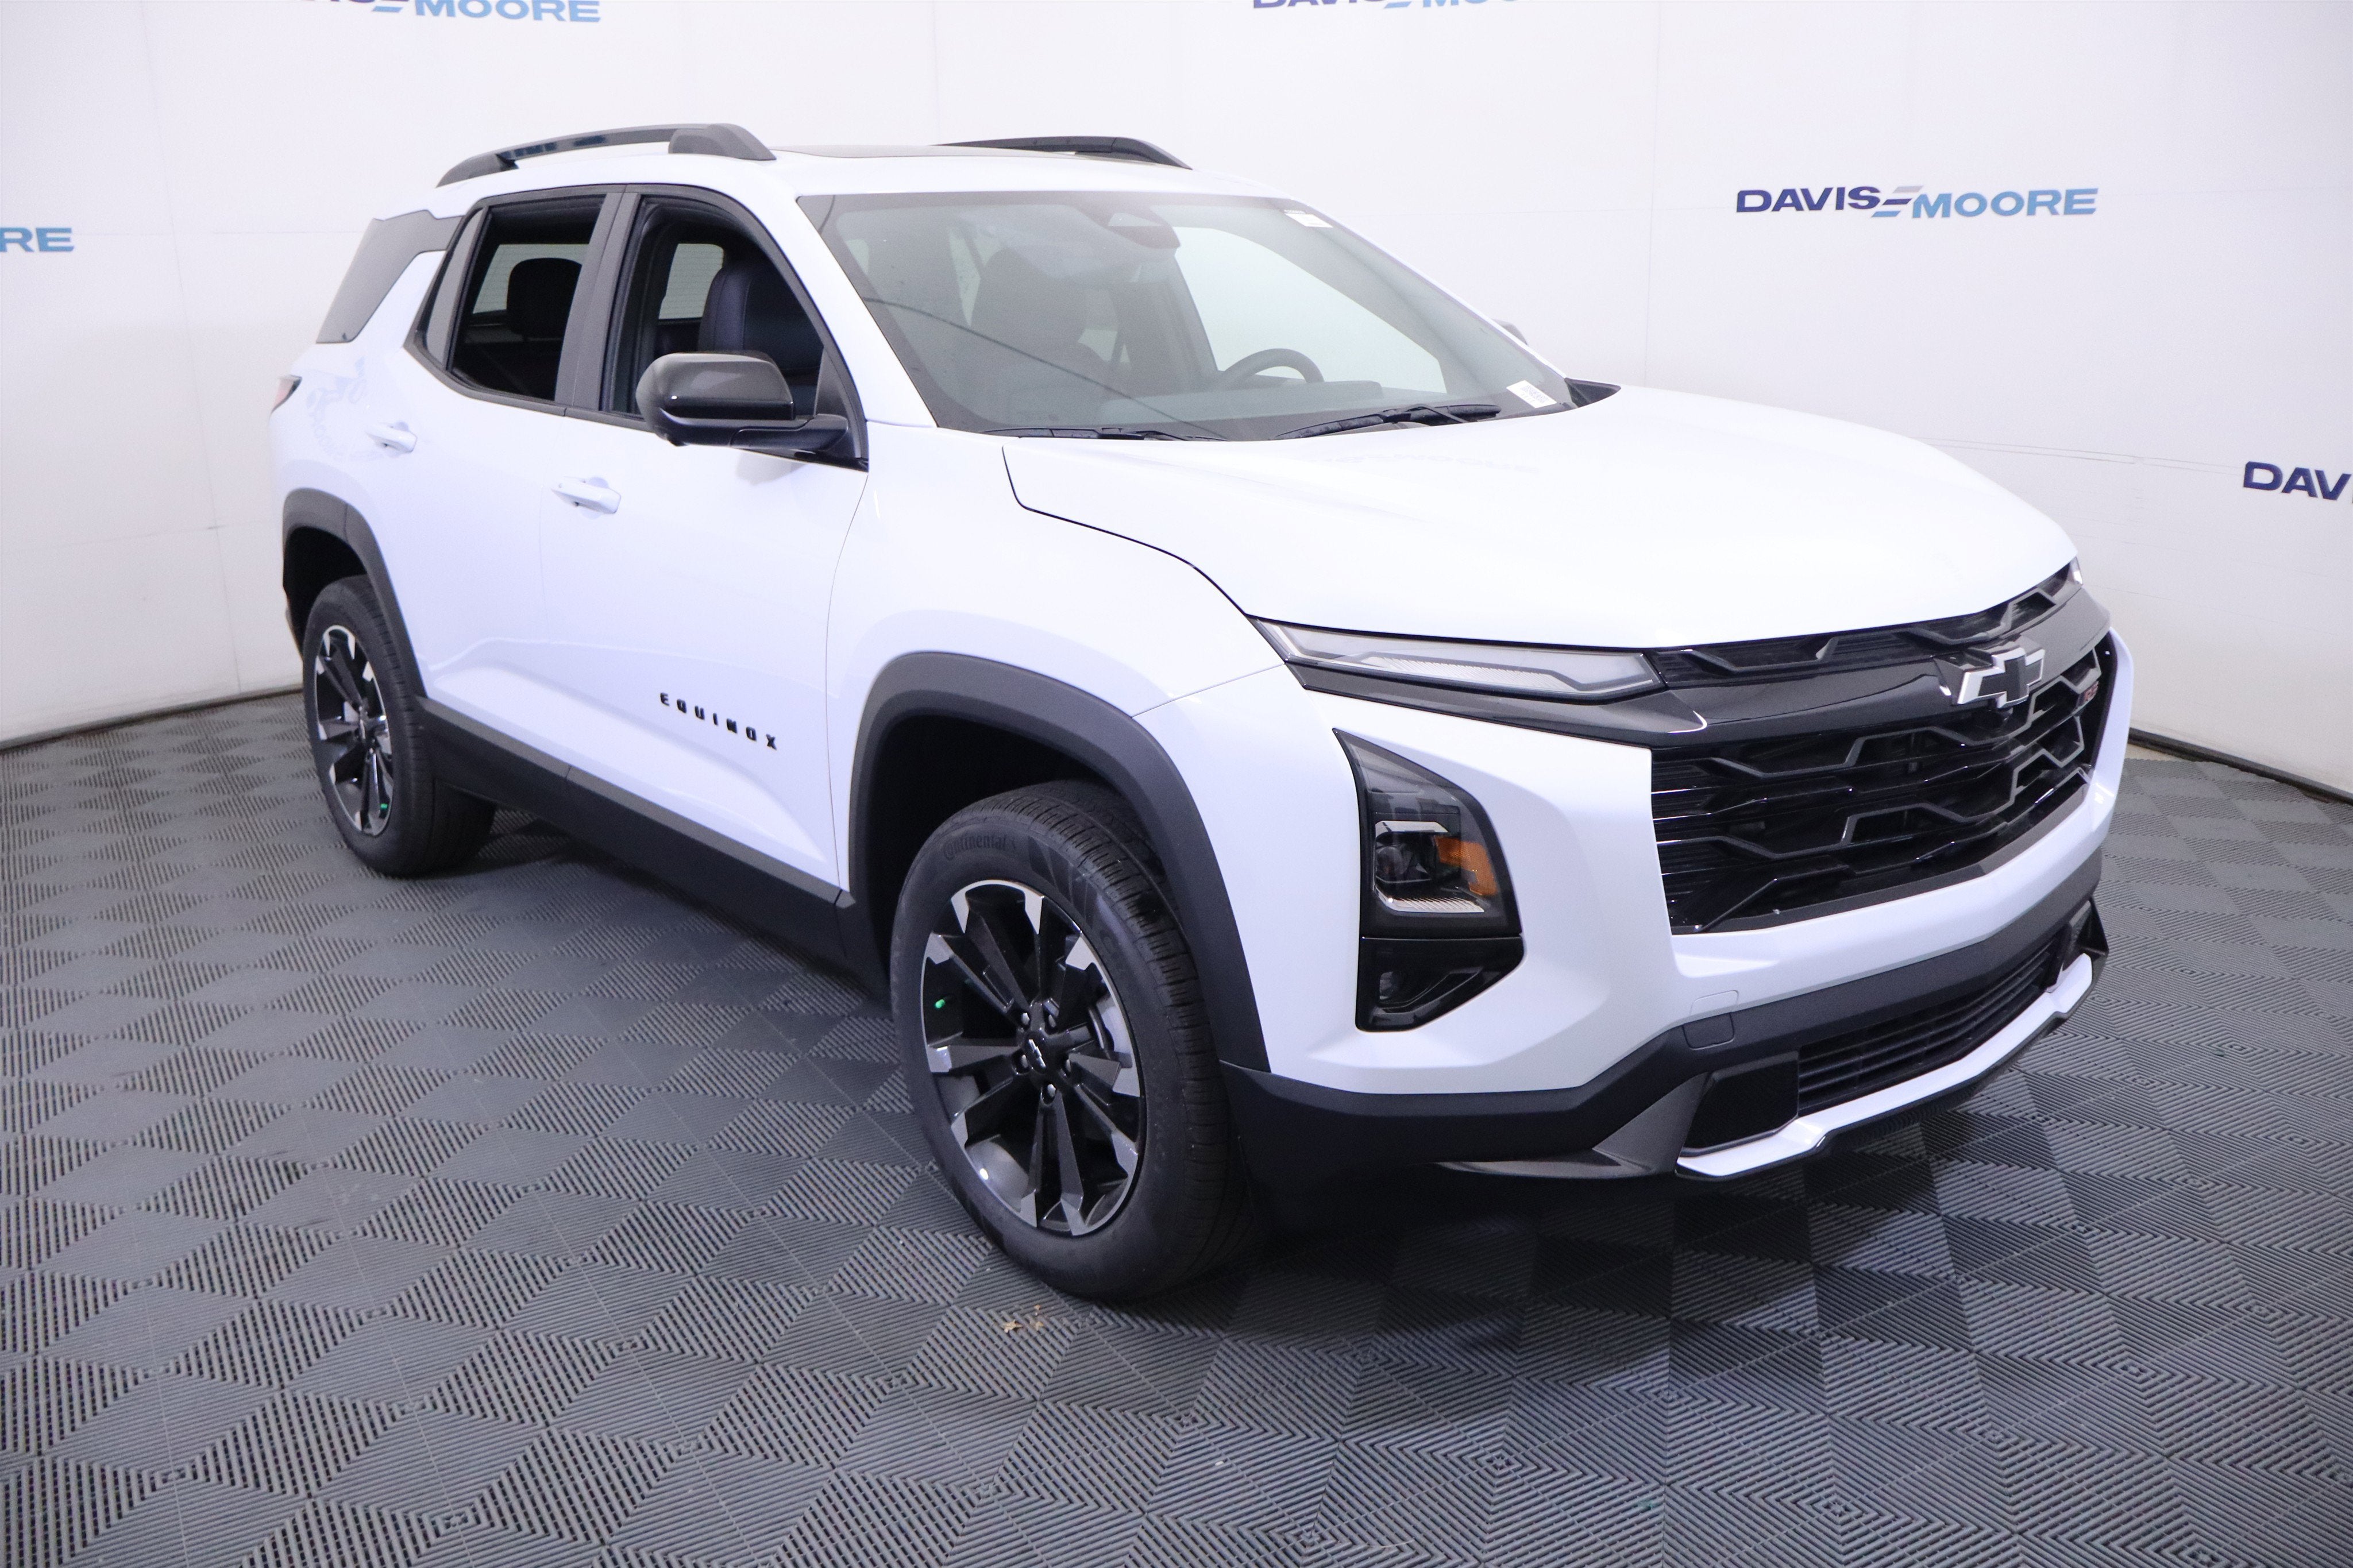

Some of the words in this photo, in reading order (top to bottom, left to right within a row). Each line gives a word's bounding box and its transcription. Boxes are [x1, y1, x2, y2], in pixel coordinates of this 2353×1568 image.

[415, 0, 601, 22] MOORE
[1737, 186, 1881, 213] DAVIS
[1912, 188, 2099, 218] MOORE
[2243, 461, 2353, 503] DAV
[659, 692, 777, 750] EQUINOX
